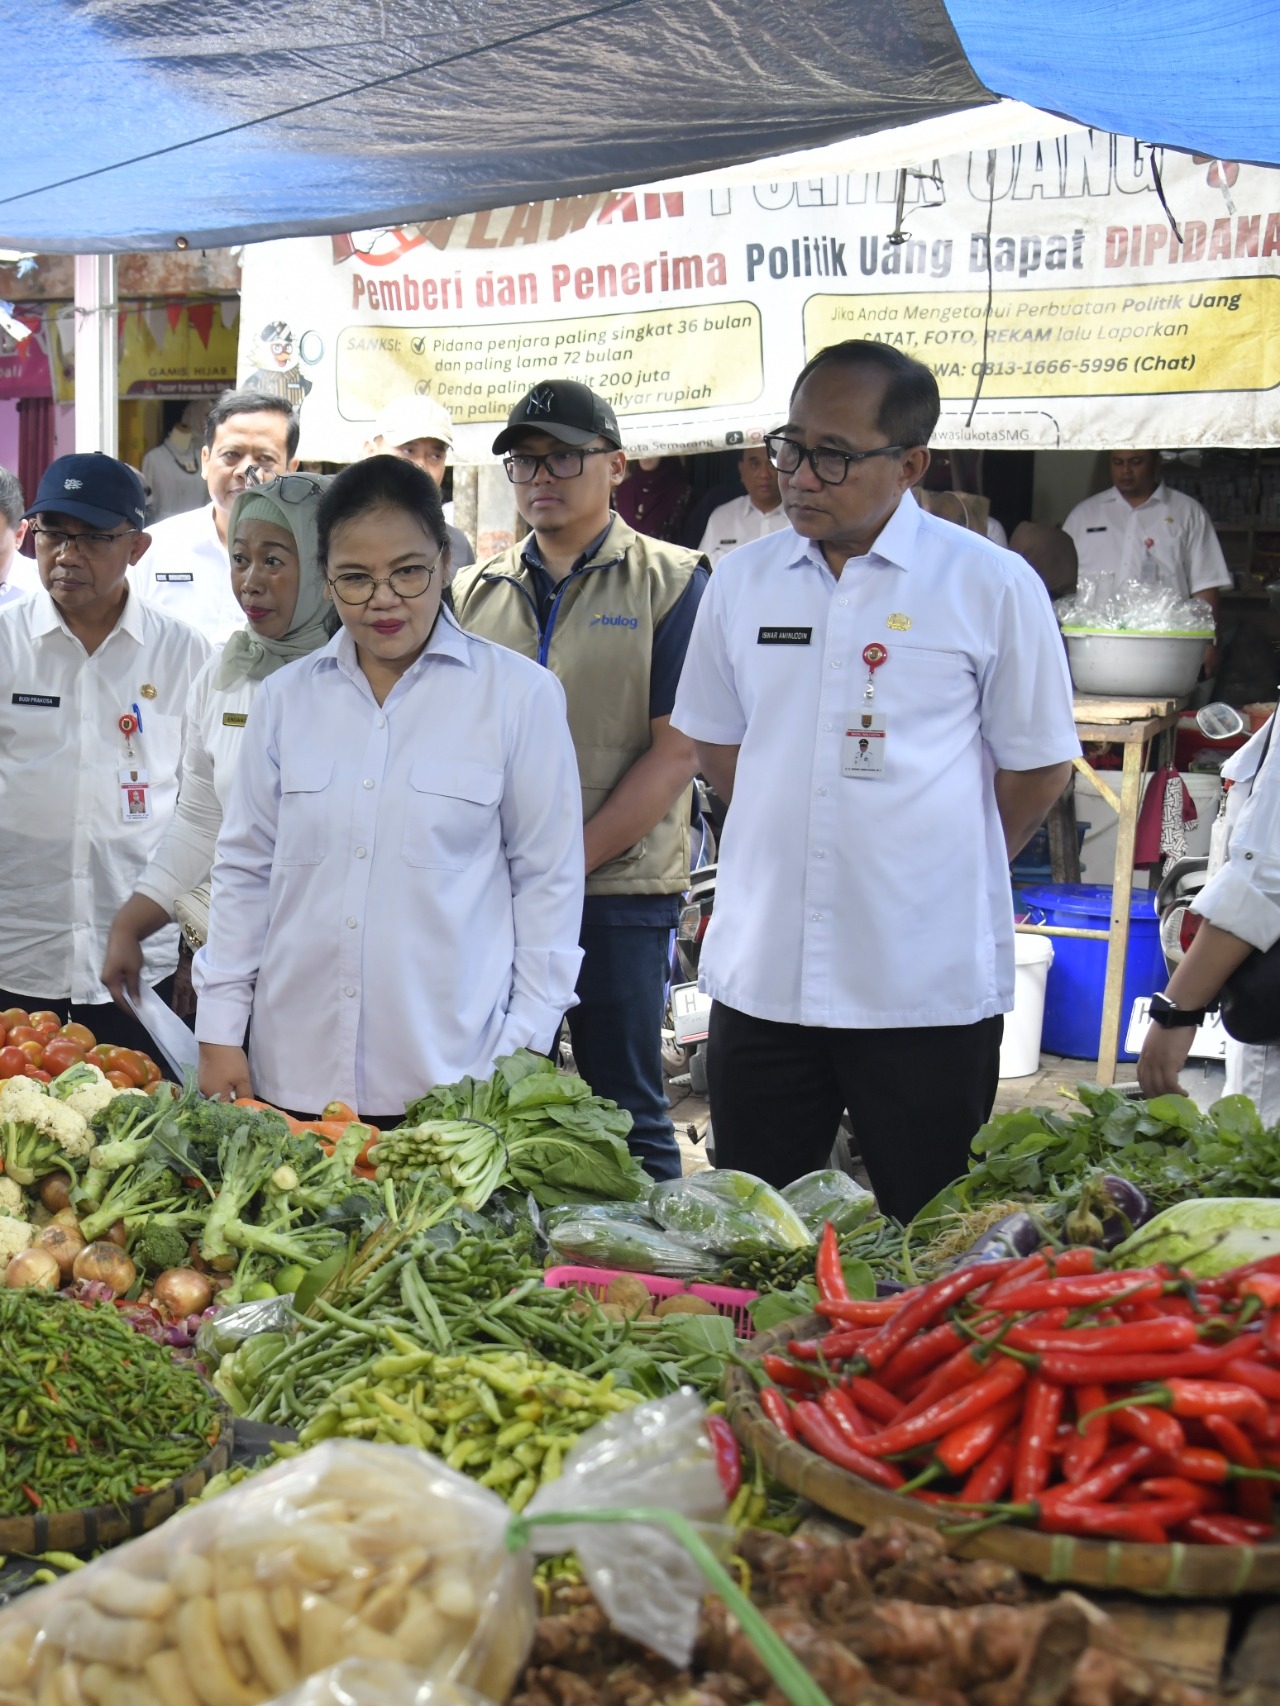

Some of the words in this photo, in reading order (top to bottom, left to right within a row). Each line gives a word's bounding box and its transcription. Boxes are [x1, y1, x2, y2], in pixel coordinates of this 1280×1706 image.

[351, 270, 463, 312] Pemberi
[476, 270, 538, 308] dan
[552, 251, 727, 303] Penerima
[746, 236, 848, 283] Politik
[859, 236, 954, 279] Uang
[969, 229, 1086, 279] Dapat
[1104, 213, 1280, 269] DIPIDANA
[831, 307, 854, 321] Jika
[857, 306, 898, 321] Anda
[903, 302, 1011, 323] Mengetahui
[1016, 300, 1115, 319] Perbuatan
[1121, 294, 1182, 312] Politik
[1188, 292, 1242, 311] Uang
[346, 337, 402, 352] SANKSI:
[433, 338, 483, 352] Pidana
[487, 335, 550, 354] penjara
[554, 330, 607, 349] paling
[612, 323, 673, 342] singkat
[677, 319, 698, 334] 36
[703, 315, 752, 332] bulan
[924, 329, 978, 346] FOTO,
[987, 328, 1052, 343] REKAM
[1057, 325, 1091, 342] lalu
[1097, 322, 1189, 343] Laporkan
[435, 358, 461, 372] dan
[465, 357, 512, 374] paling
[516, 355, 558, 369] lama
[563, 352, 580, 365] 72
[585, 348, 633, 364] bulan
[933, 363, 967, 377] WA:
[971, 357, 1128, 377] 0813-1666-5996
[1134, 353, 1196, 374] (Chat)
[437, 382, 482, 396] Denda
[486, 380, 536, 398] paling
[598, 371, 632, 387] 200
[634, 368, 670, 387] juta
[656, 385, 712, 402] rupiah
[622, 440, 650, 453] Kota
[652, 438, 714, 451] Semarang
[930, 428, 1030, 442] awaslukotaSMG
[601, 614, 638, 629] bulog
[685, 993, 697, 1014] H
